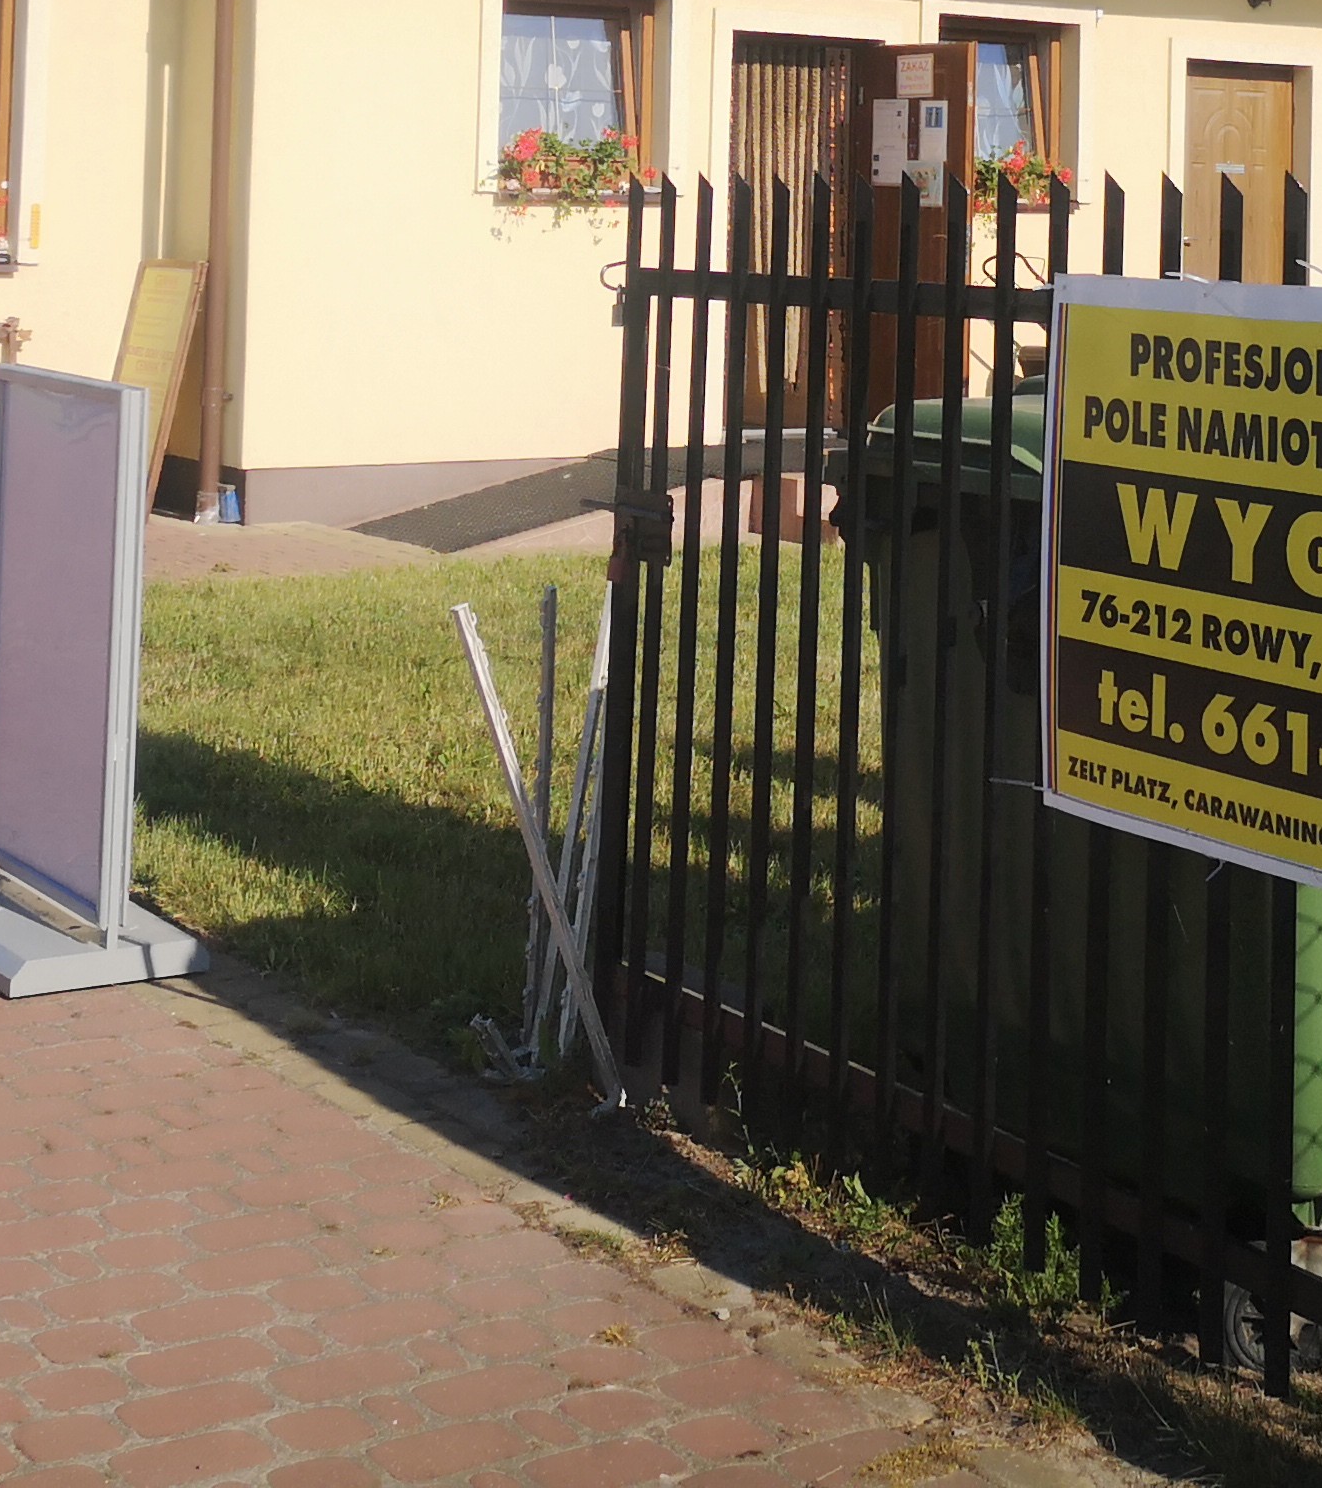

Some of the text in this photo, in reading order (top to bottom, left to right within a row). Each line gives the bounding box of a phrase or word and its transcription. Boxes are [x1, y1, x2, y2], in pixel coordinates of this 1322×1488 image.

[1083, 396, 1168, 448] POLE
[1080, 589, 1193, 645] 76-212
[1201, 613, 1322, 681] ROWY,
[1097, 669, 1185, 745] tel.
[1067, 754, 1108, 788] ZELT
[1111, 767, 1179, 810] PLATZ,
